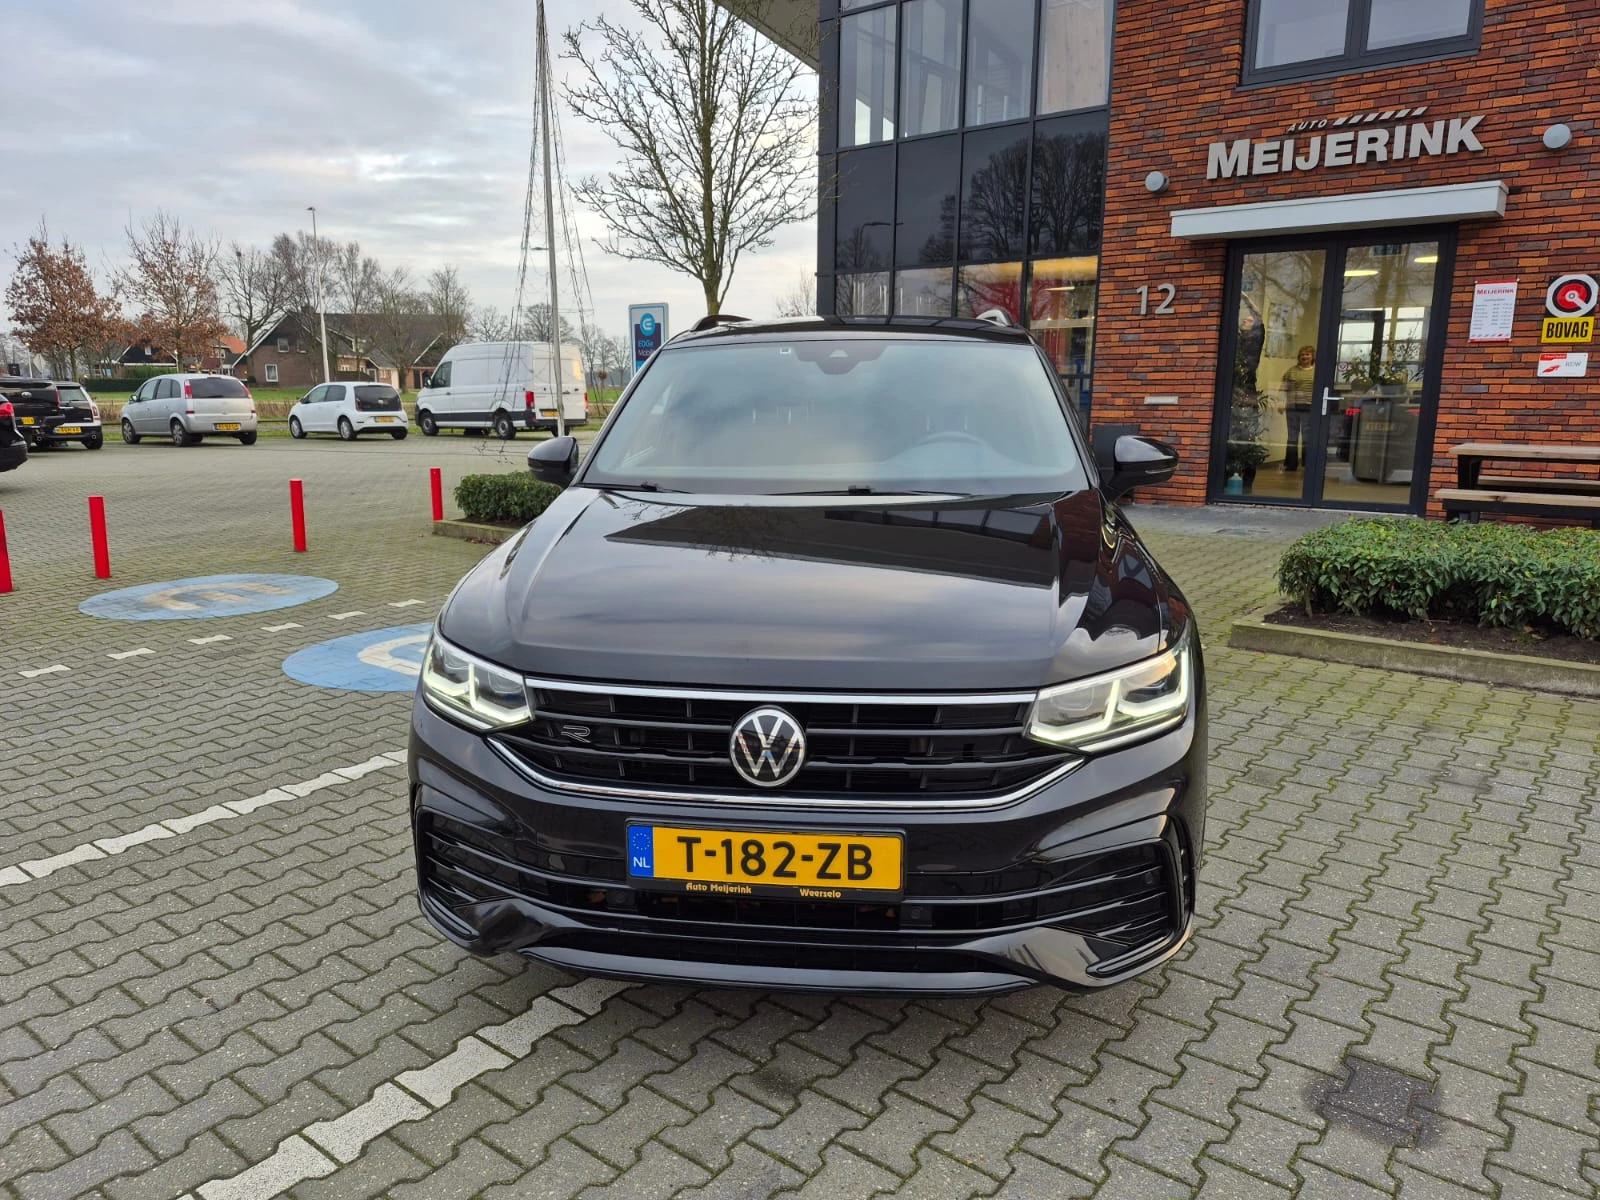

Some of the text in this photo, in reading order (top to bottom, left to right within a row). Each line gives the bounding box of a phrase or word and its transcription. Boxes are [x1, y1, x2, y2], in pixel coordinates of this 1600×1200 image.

[1288, 119, 1327, 132] AUTO
[1206, 114, 1486, 180] MEIJERINK
[1136, 283, 1176, 315] 12
[1546, 321, 1589, 339] BOVAG
[633, 856, 651, 869] NL
[677, 835, 873, 881] T-182-ZB
[685, 882, 752, 895] Auto Meijerink
[799, 888, 842, 899] Weerselo
